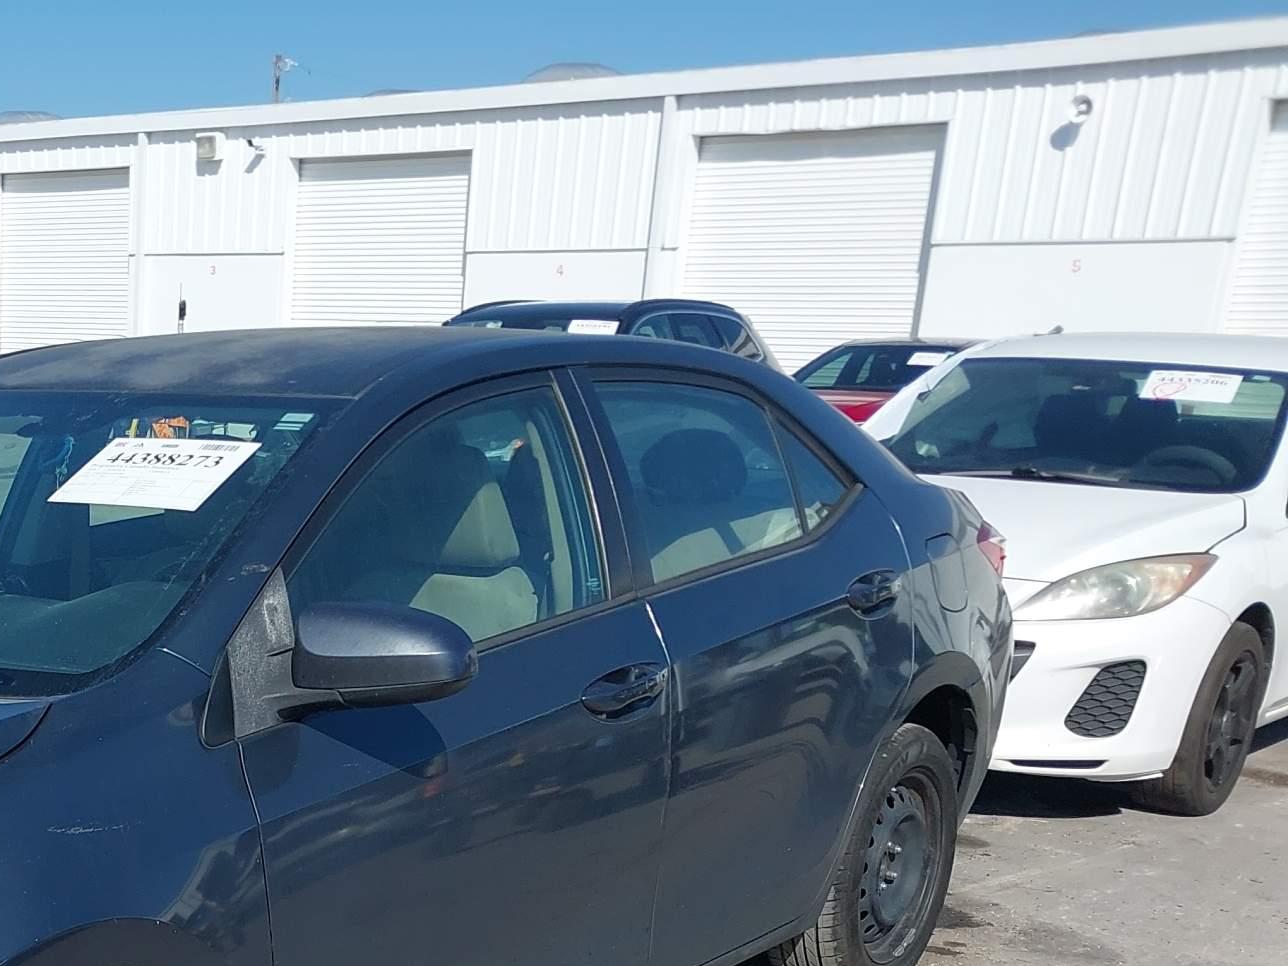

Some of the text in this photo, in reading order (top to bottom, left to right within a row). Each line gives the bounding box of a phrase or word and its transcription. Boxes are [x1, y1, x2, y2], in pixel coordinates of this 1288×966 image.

[208, 265, 216, 276] 3
[556, 264, 564, 276] 4
[106, 452, 224, 468] 44388273
